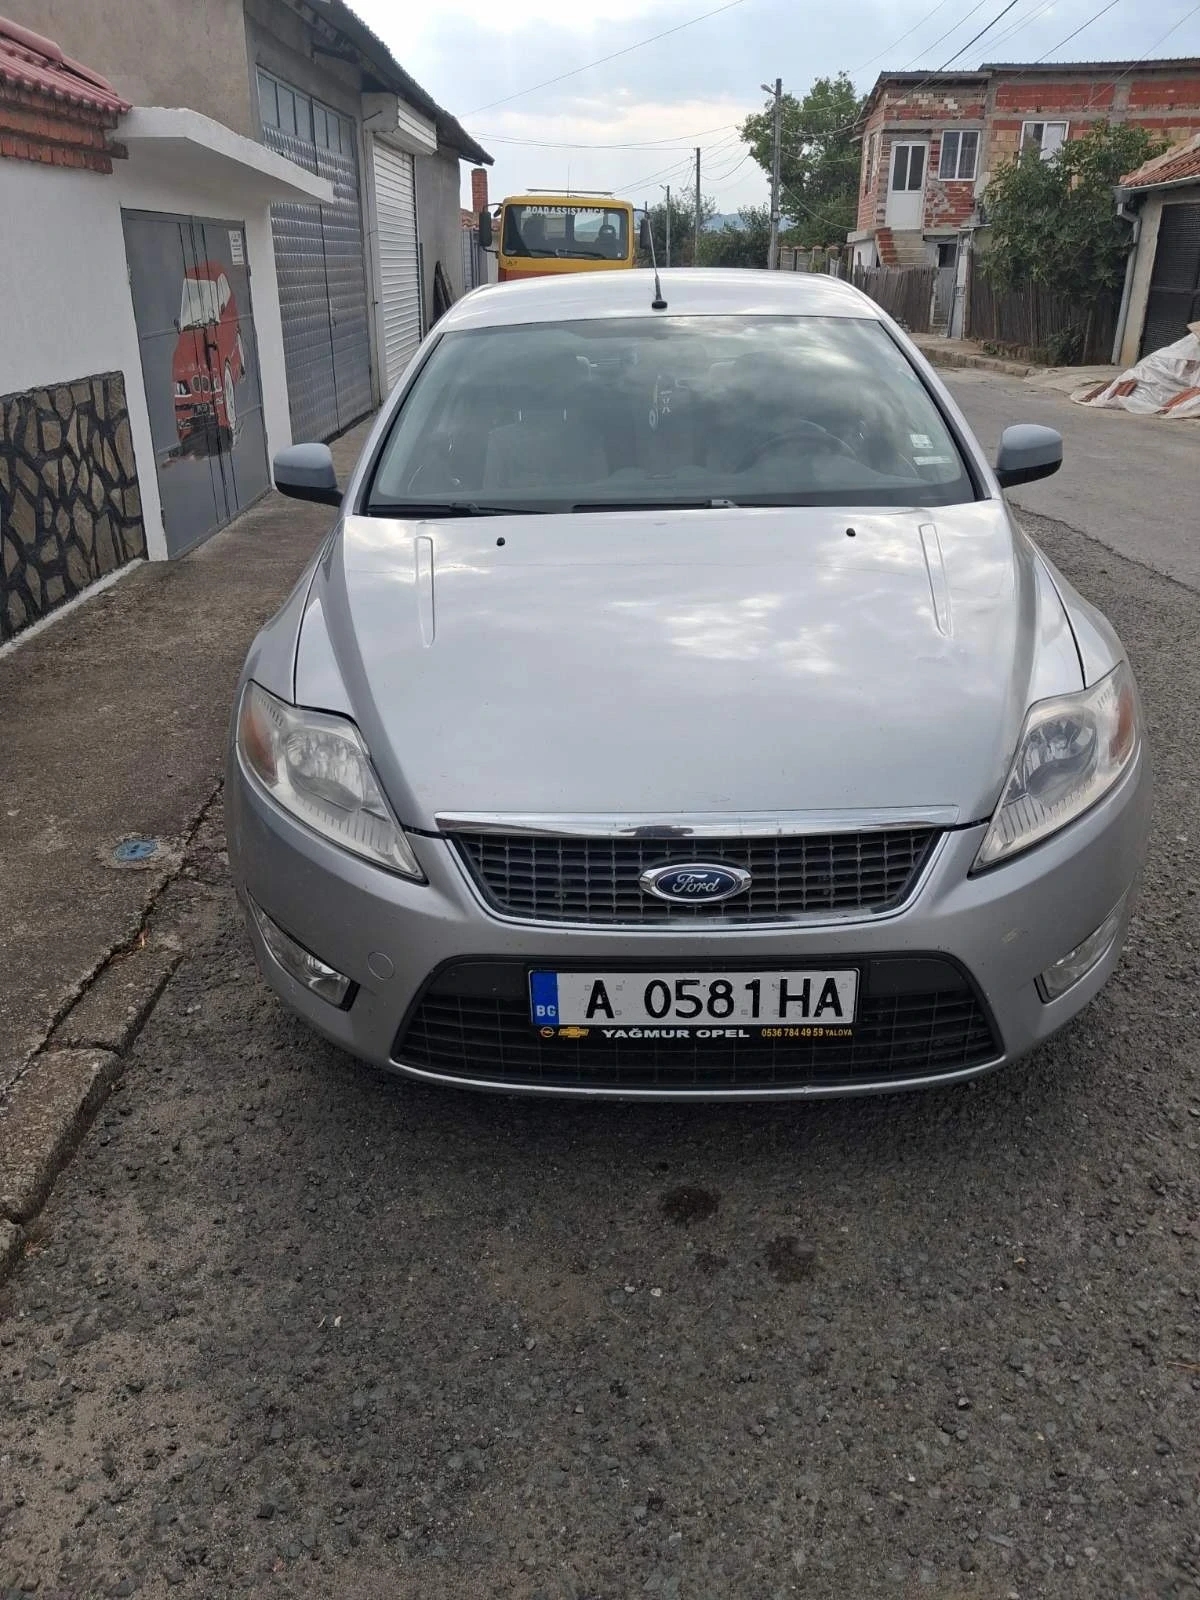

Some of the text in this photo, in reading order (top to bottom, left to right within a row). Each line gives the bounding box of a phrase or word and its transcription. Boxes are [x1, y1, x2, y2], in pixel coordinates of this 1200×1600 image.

[526, 206, 549, 215] ROAD
[672, 873, 720, 893] Ford
[585, 977, 843, 1019] A 0581 HA
[536, 1005, 556, 1017] BG
[601, 1027, 750, 1039] YAĞMUR OPEL
[761, 1028, 853, 1037] 0536 784 49 59 YALOVA
